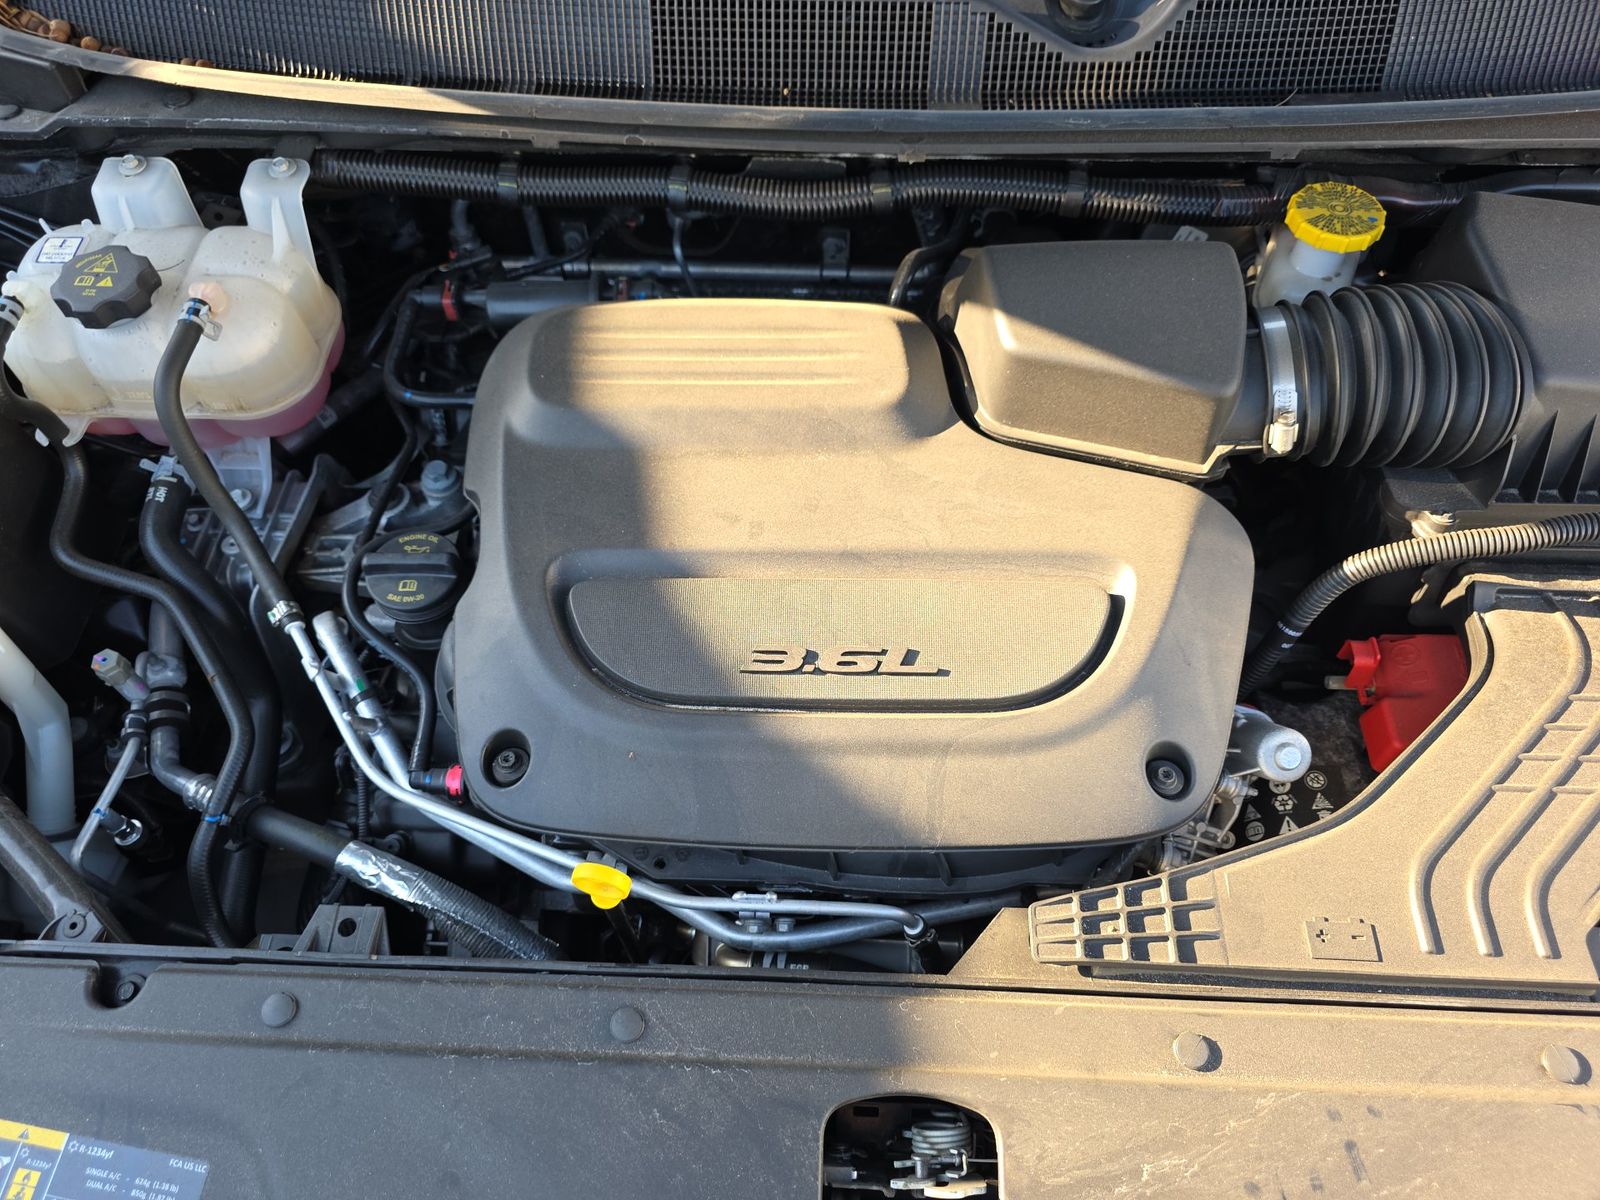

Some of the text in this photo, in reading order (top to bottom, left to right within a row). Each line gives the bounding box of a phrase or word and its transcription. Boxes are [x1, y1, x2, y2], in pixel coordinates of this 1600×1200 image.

[155, 486, 168, 502] HOT
[398, 534, 439, 544] ENGINE OIL
[386, 593, 401, 602] SAE
[740, 644, 940, 676] 3.6L
[79, 1144, 115, 1160] R-1234yf
[169, 1158, 208, 1173] FCA US LLC
[85, 1166, 108, 1177] SINGLE
[108, 1170, 122, 1181] A/C
[170, 1184, 180, 1194] lb)
[85, 1179, 103, 1190] DUAL
[104, 1182, 118, 1193] A/C
